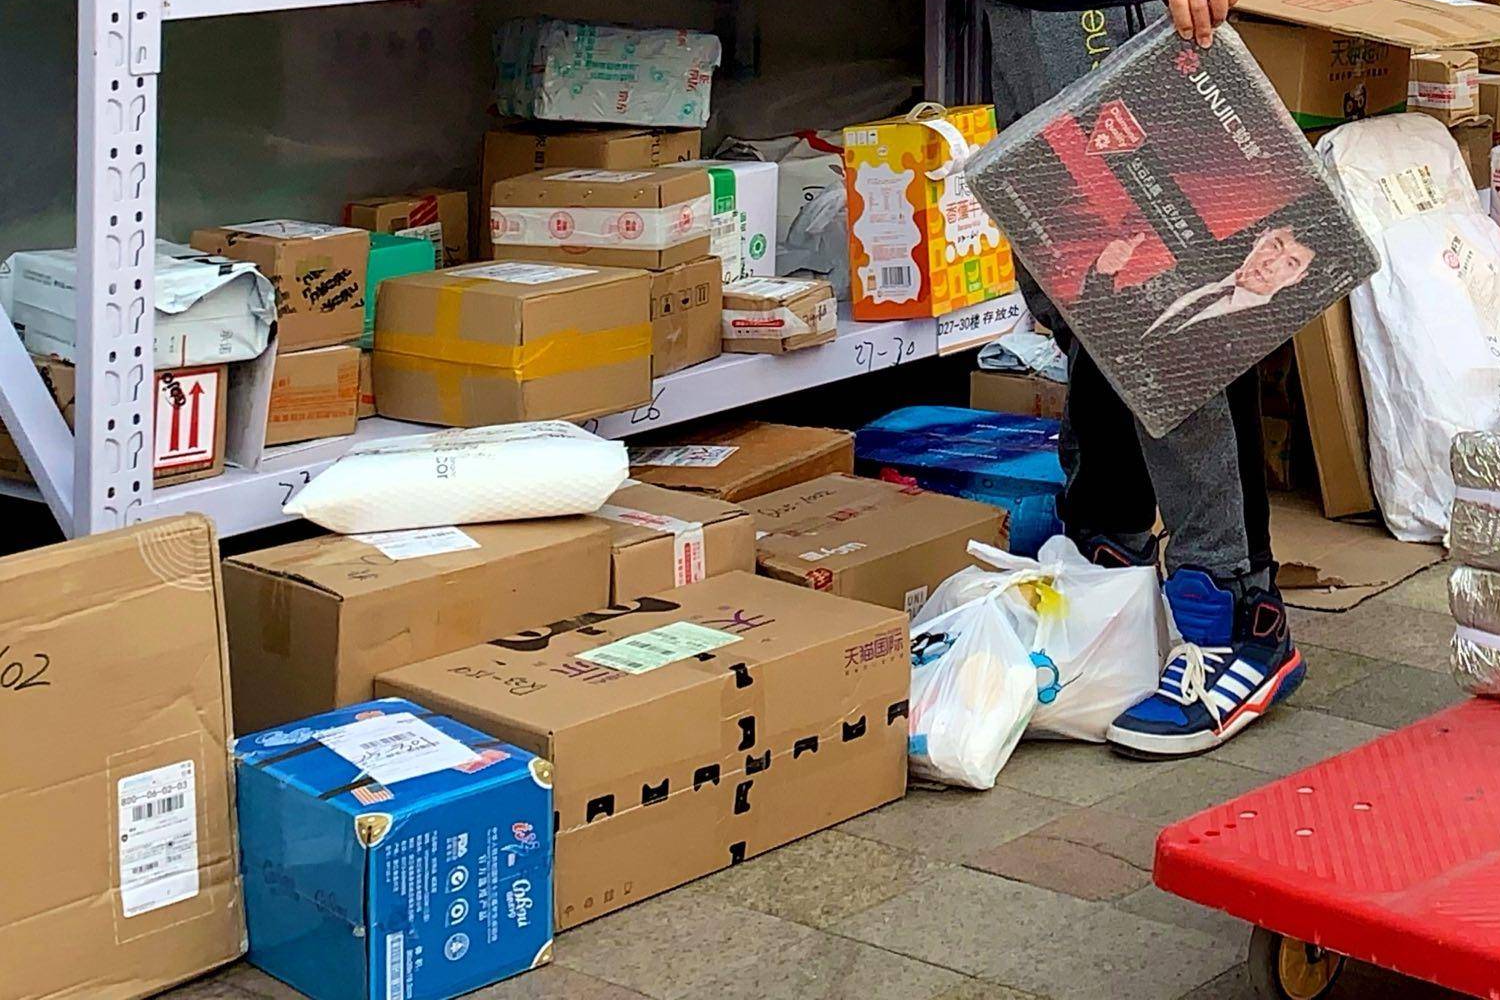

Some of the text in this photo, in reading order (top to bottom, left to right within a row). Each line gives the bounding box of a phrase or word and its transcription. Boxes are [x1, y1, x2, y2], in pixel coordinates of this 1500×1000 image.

[1104, 118, 1127, 147] Quality
[1110, 106, 1140, 144] Diamond
[982, 304, 1020, 325] 存放处
[844, 631, 904, 669] 天猫国际
